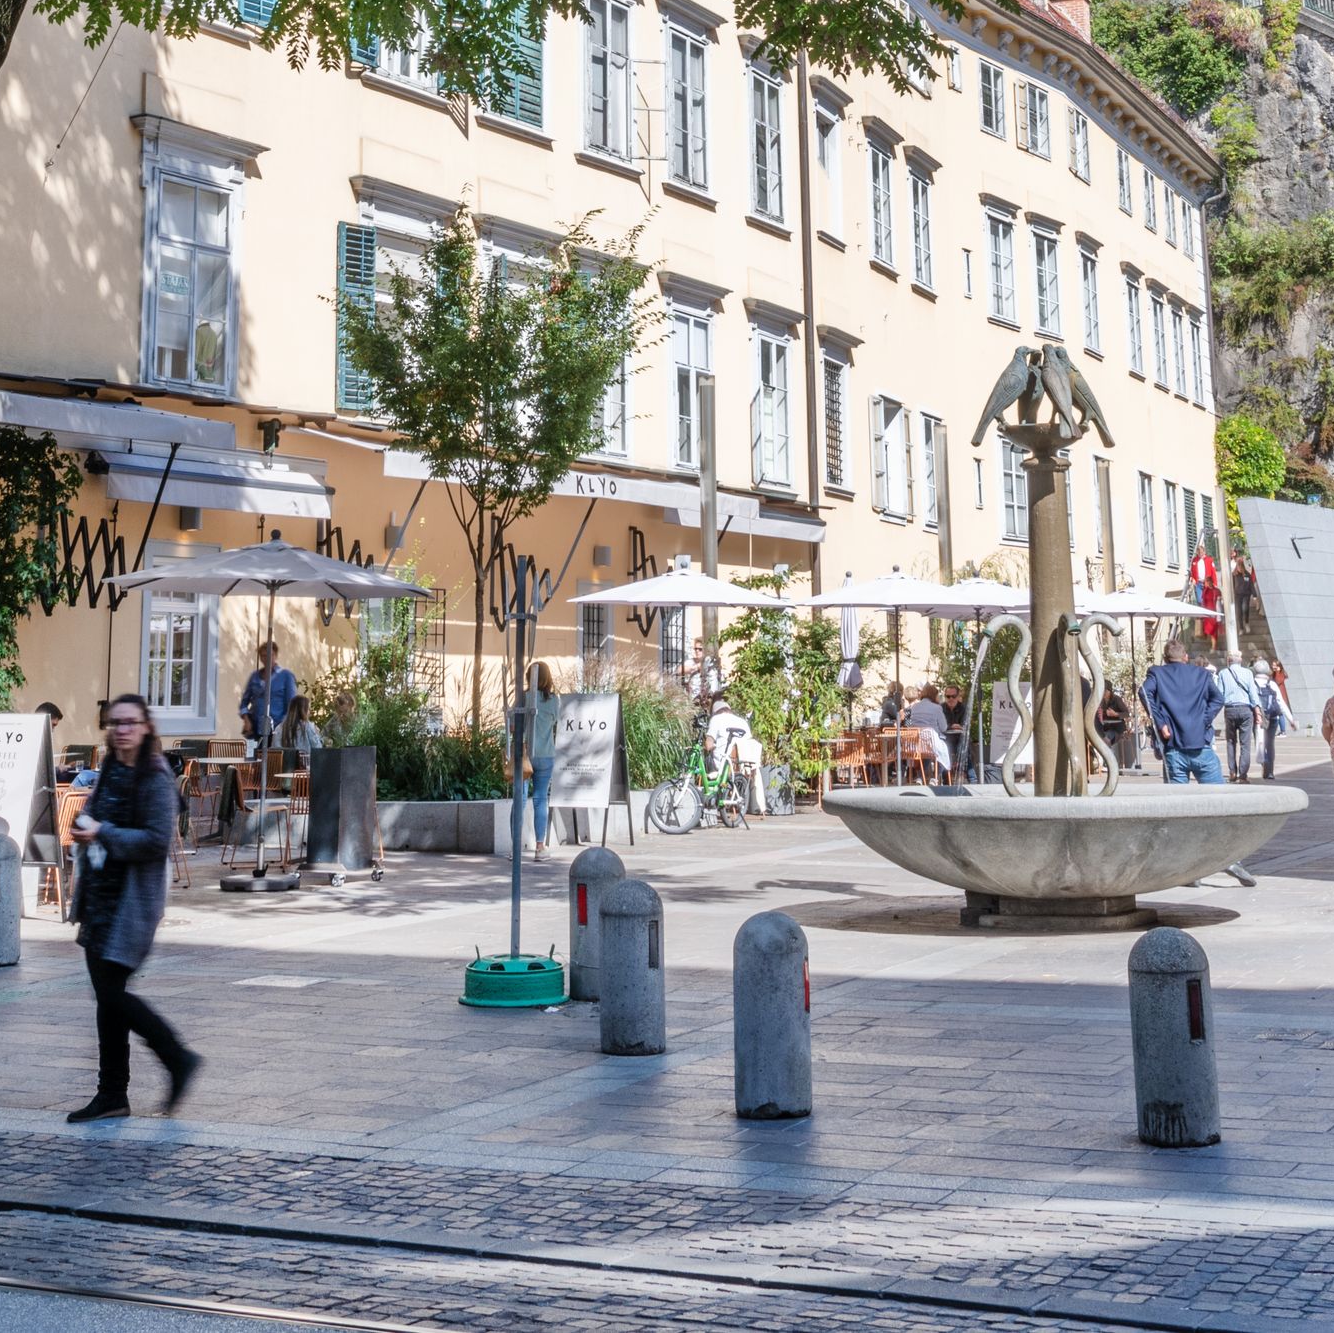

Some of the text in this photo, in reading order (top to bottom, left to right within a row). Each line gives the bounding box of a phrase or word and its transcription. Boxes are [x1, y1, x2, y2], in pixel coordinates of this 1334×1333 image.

[575, 474, 617, 496] KLYO
[999, 700, 1032, 710] KLO
[565, 719, 607, 732] KLYO
